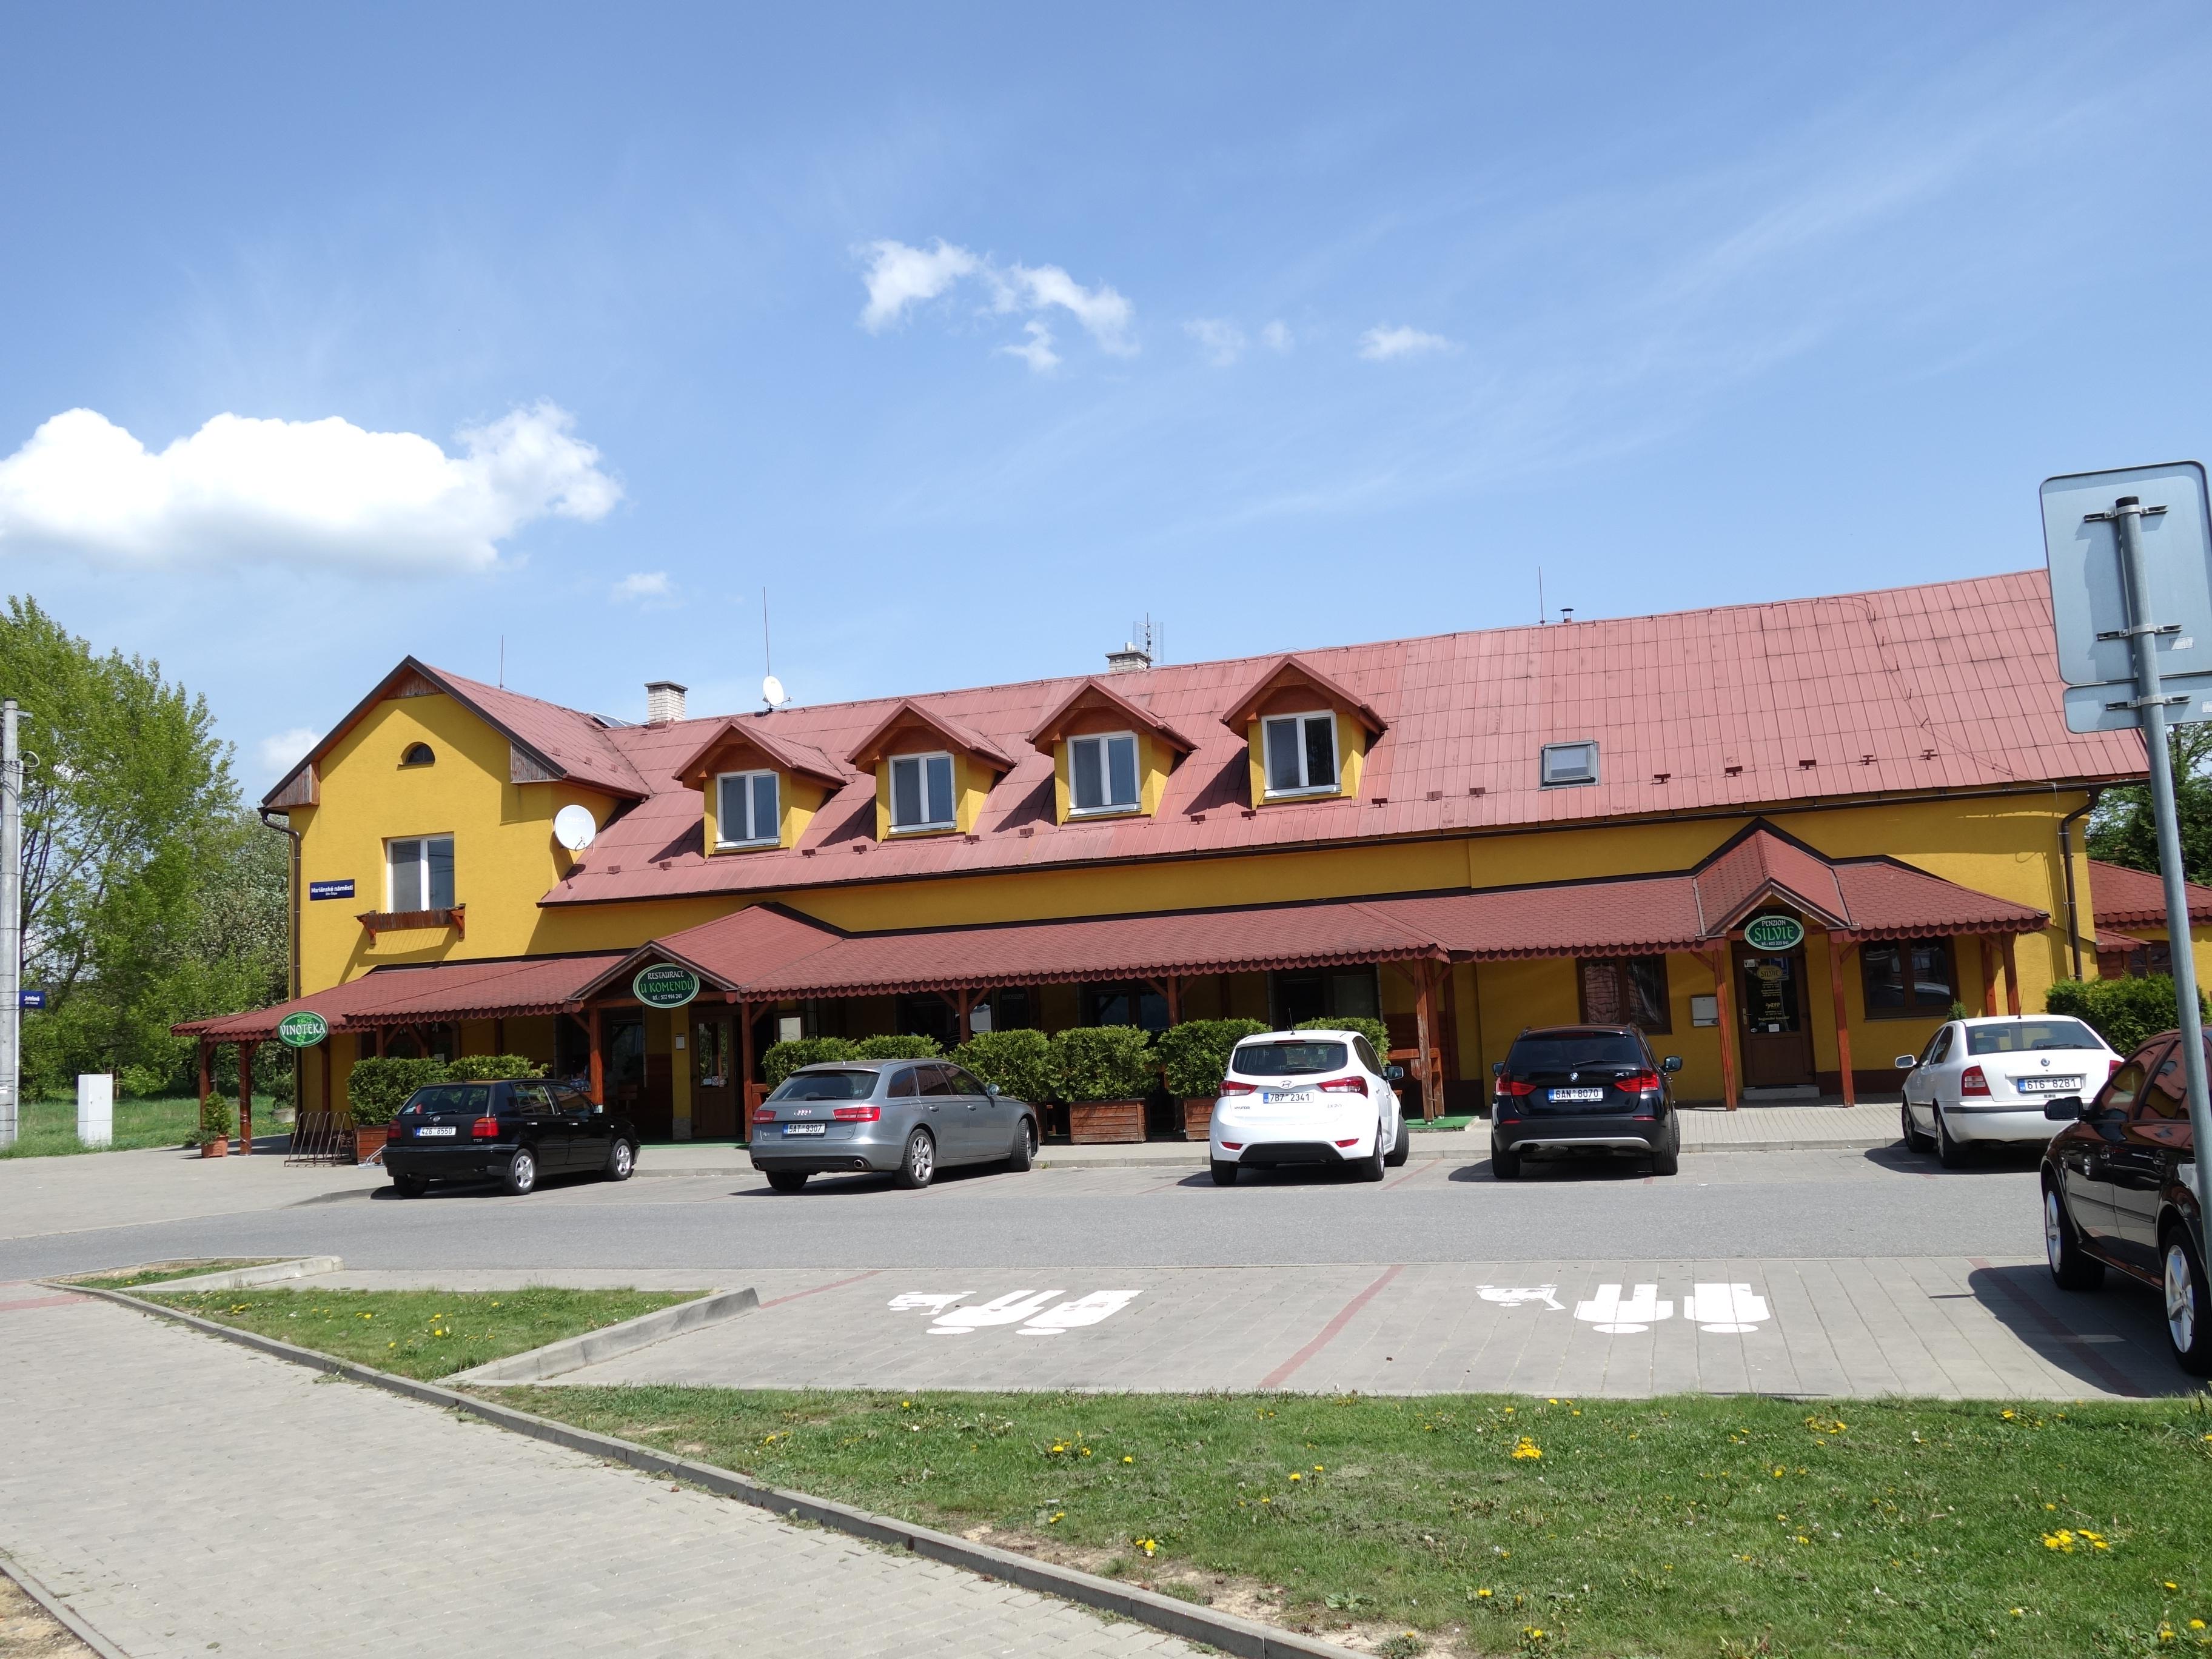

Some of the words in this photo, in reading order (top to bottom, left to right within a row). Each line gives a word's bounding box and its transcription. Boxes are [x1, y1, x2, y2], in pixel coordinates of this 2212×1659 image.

[1754, 927, 1795, 941] SILVIE
[648, 970, 684, 980] RESTAURACE
[640, 983, 647, 994] U
[649, 977, 694, 993] KOMENDŮ
[2027, 1080, 2045, 1090] 6T6
[2052, 1078, 2077, 1088] 8281
[1270, 1093, 1284, 1102] 7B7
[1290, 1093, 1310, 1102] 2341
[1556, 1090, 1571, 1099] 6AN
[1578, 1088, 1599, 1098] 8070
[421, 1127, 432, 1135] 4Z6
